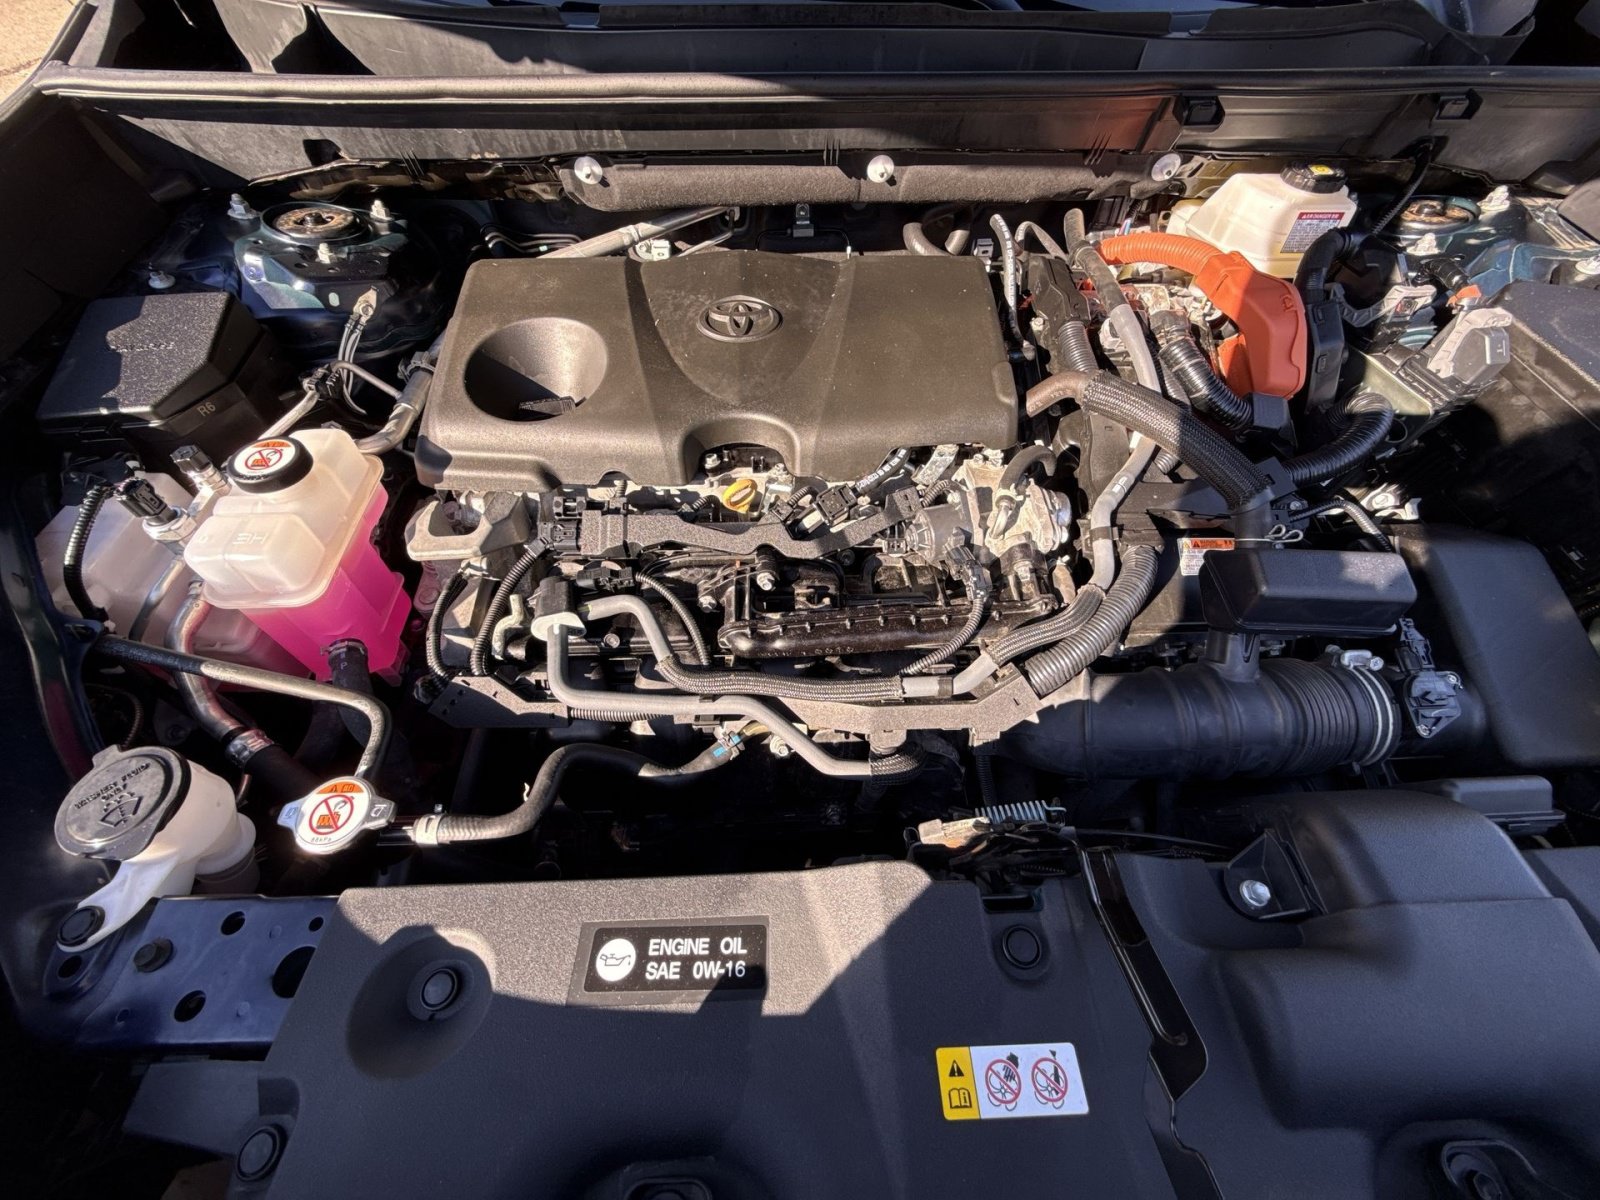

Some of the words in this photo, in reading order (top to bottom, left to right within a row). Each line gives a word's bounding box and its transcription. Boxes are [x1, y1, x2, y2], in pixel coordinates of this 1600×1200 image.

[197, 402, 216, 417] R6
[648, 938, 710, 956] ENGINE
[720, 937, 748, 955] OIL
[645, 961, 682, 980] SAE
[692, 960, 746, 980] 0W-16
